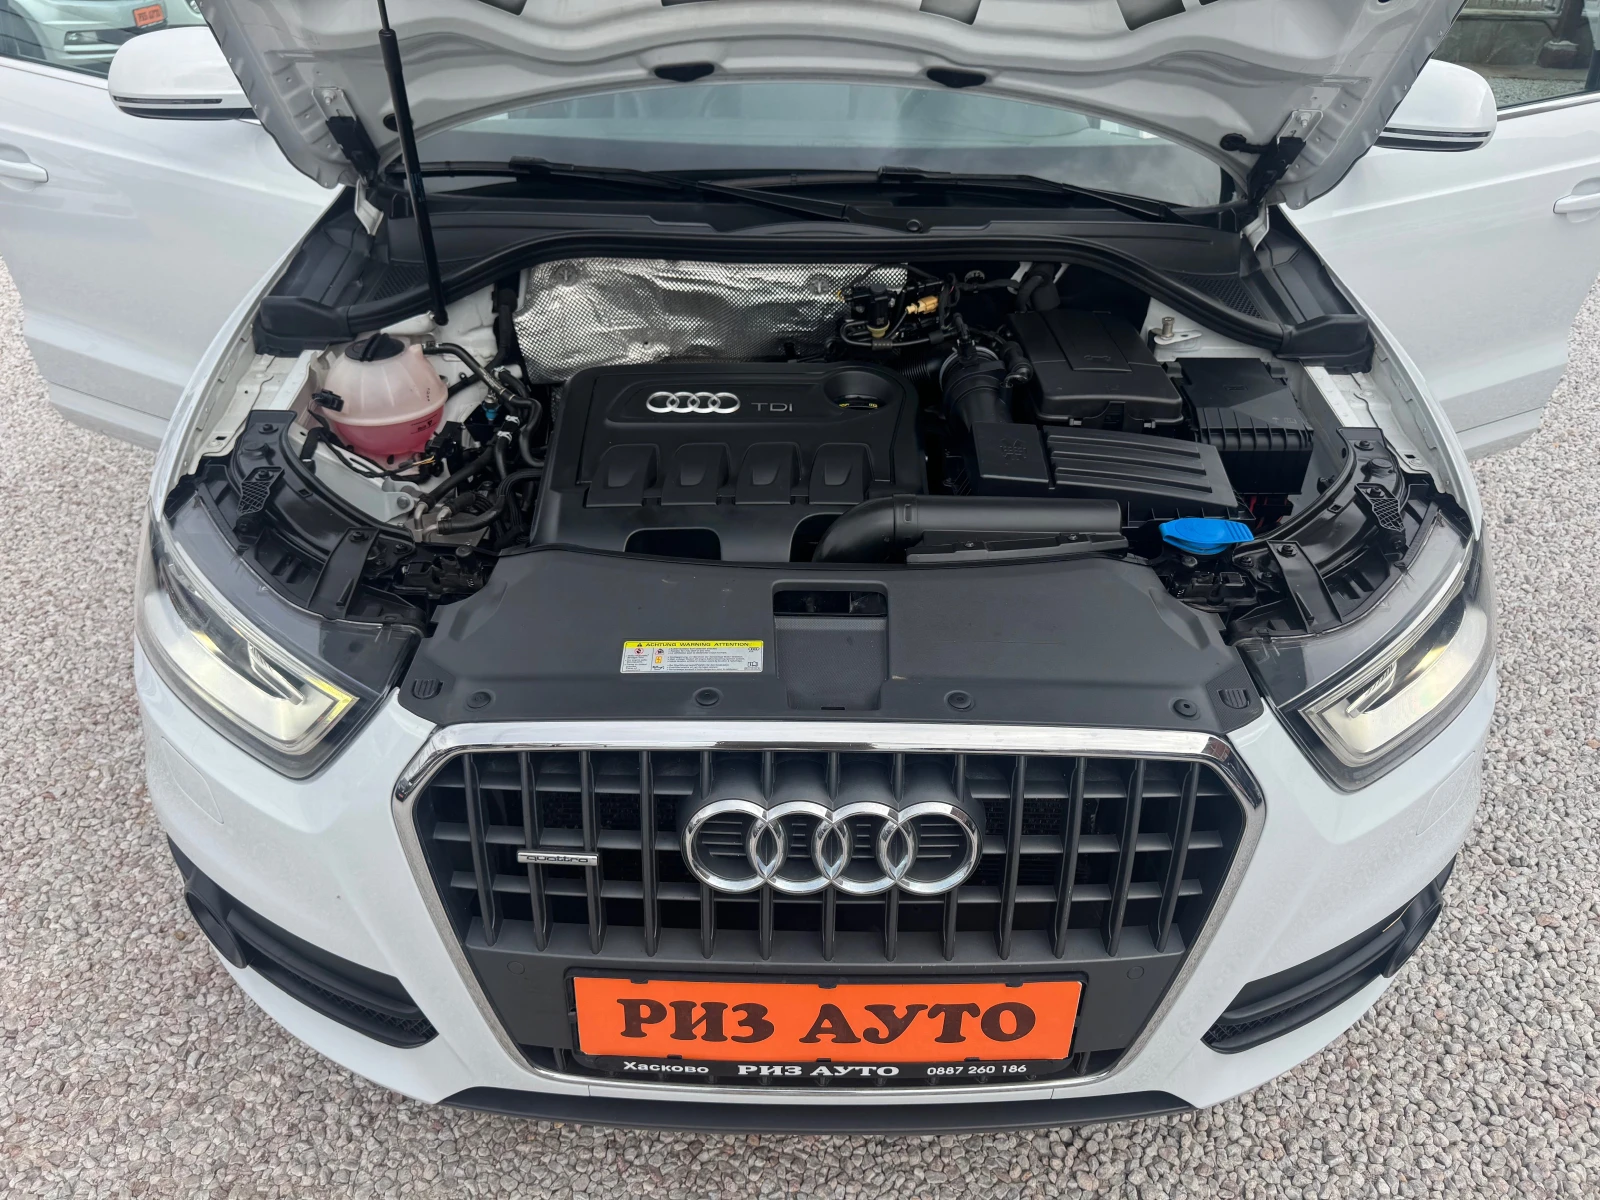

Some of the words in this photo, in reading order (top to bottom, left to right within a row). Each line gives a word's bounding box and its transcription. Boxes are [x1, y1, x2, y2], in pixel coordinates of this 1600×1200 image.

[751, 403, 792, 412] TDI
[617, 998, 774, 1043] РИЗ
[799, 1002, 1036, 1044] АУТО
[623, 1061, 709, 1074] Хасково
[737, 1065, 802, 1077] РИЗ
[809, 1065, 899, 1076] АУТО
[926, 1066, 964, 1076] 0887
[967, 1065, 997, 1075] 260
[1001, 1063, 1028, 1074] 186
